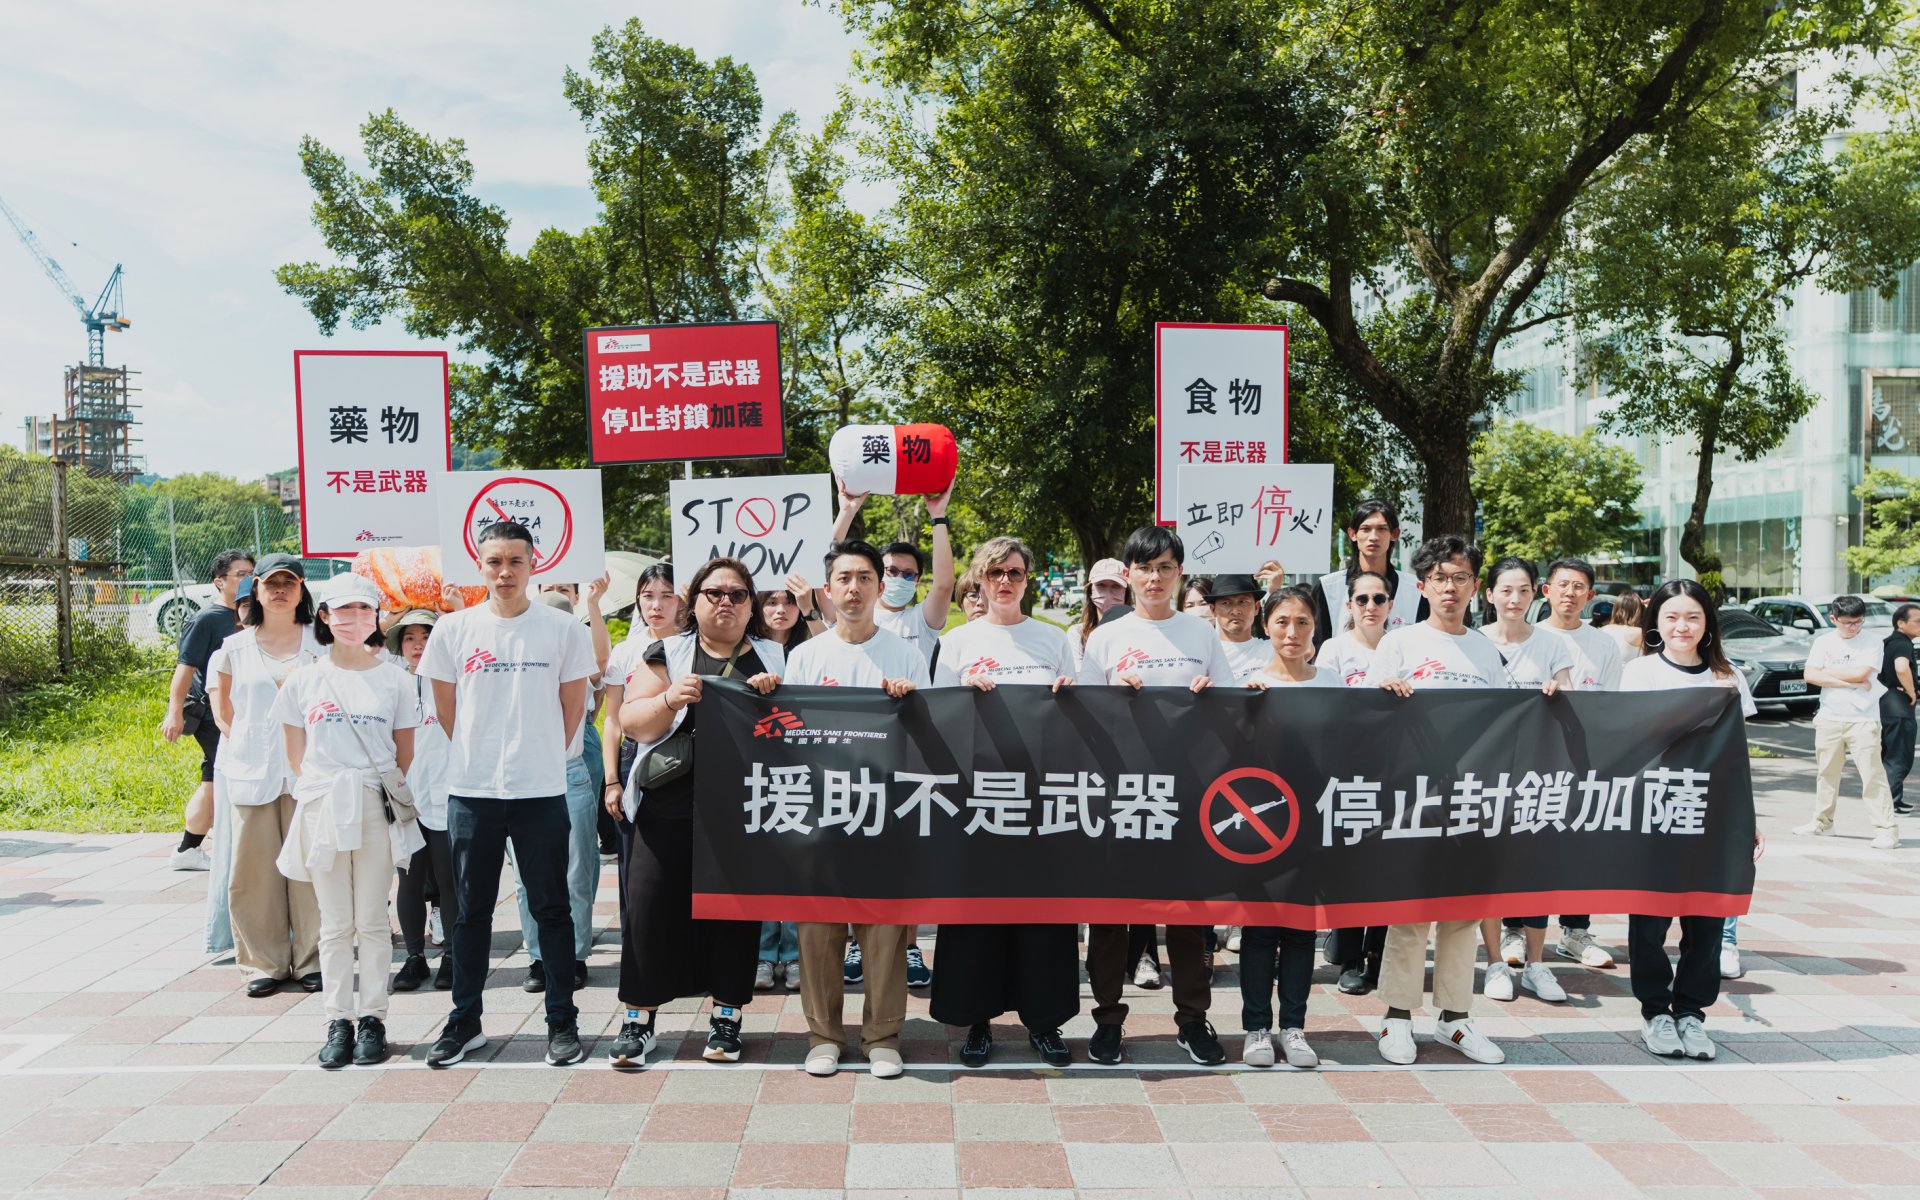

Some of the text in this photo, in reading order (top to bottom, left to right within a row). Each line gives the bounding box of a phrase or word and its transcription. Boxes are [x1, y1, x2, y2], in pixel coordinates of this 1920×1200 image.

[599, 358, 761, 392] 援助不是武器
[1184, 377, 1262, 416] 食物
[329, 405, 420, 444] 藥物
[602, 401, 764, 435] 停止封鎖加薩
[861, 434, 932, 465] 藥物
[1179, 440, 1267, 464] 不是武器
[326, 469, 428, 494] 不是武器
[785, 728, 888, 739] MEDECINS SANS FRONTIERES
[743, 762, 1711, 847] 援助不是武器 停止封鎖加薩
